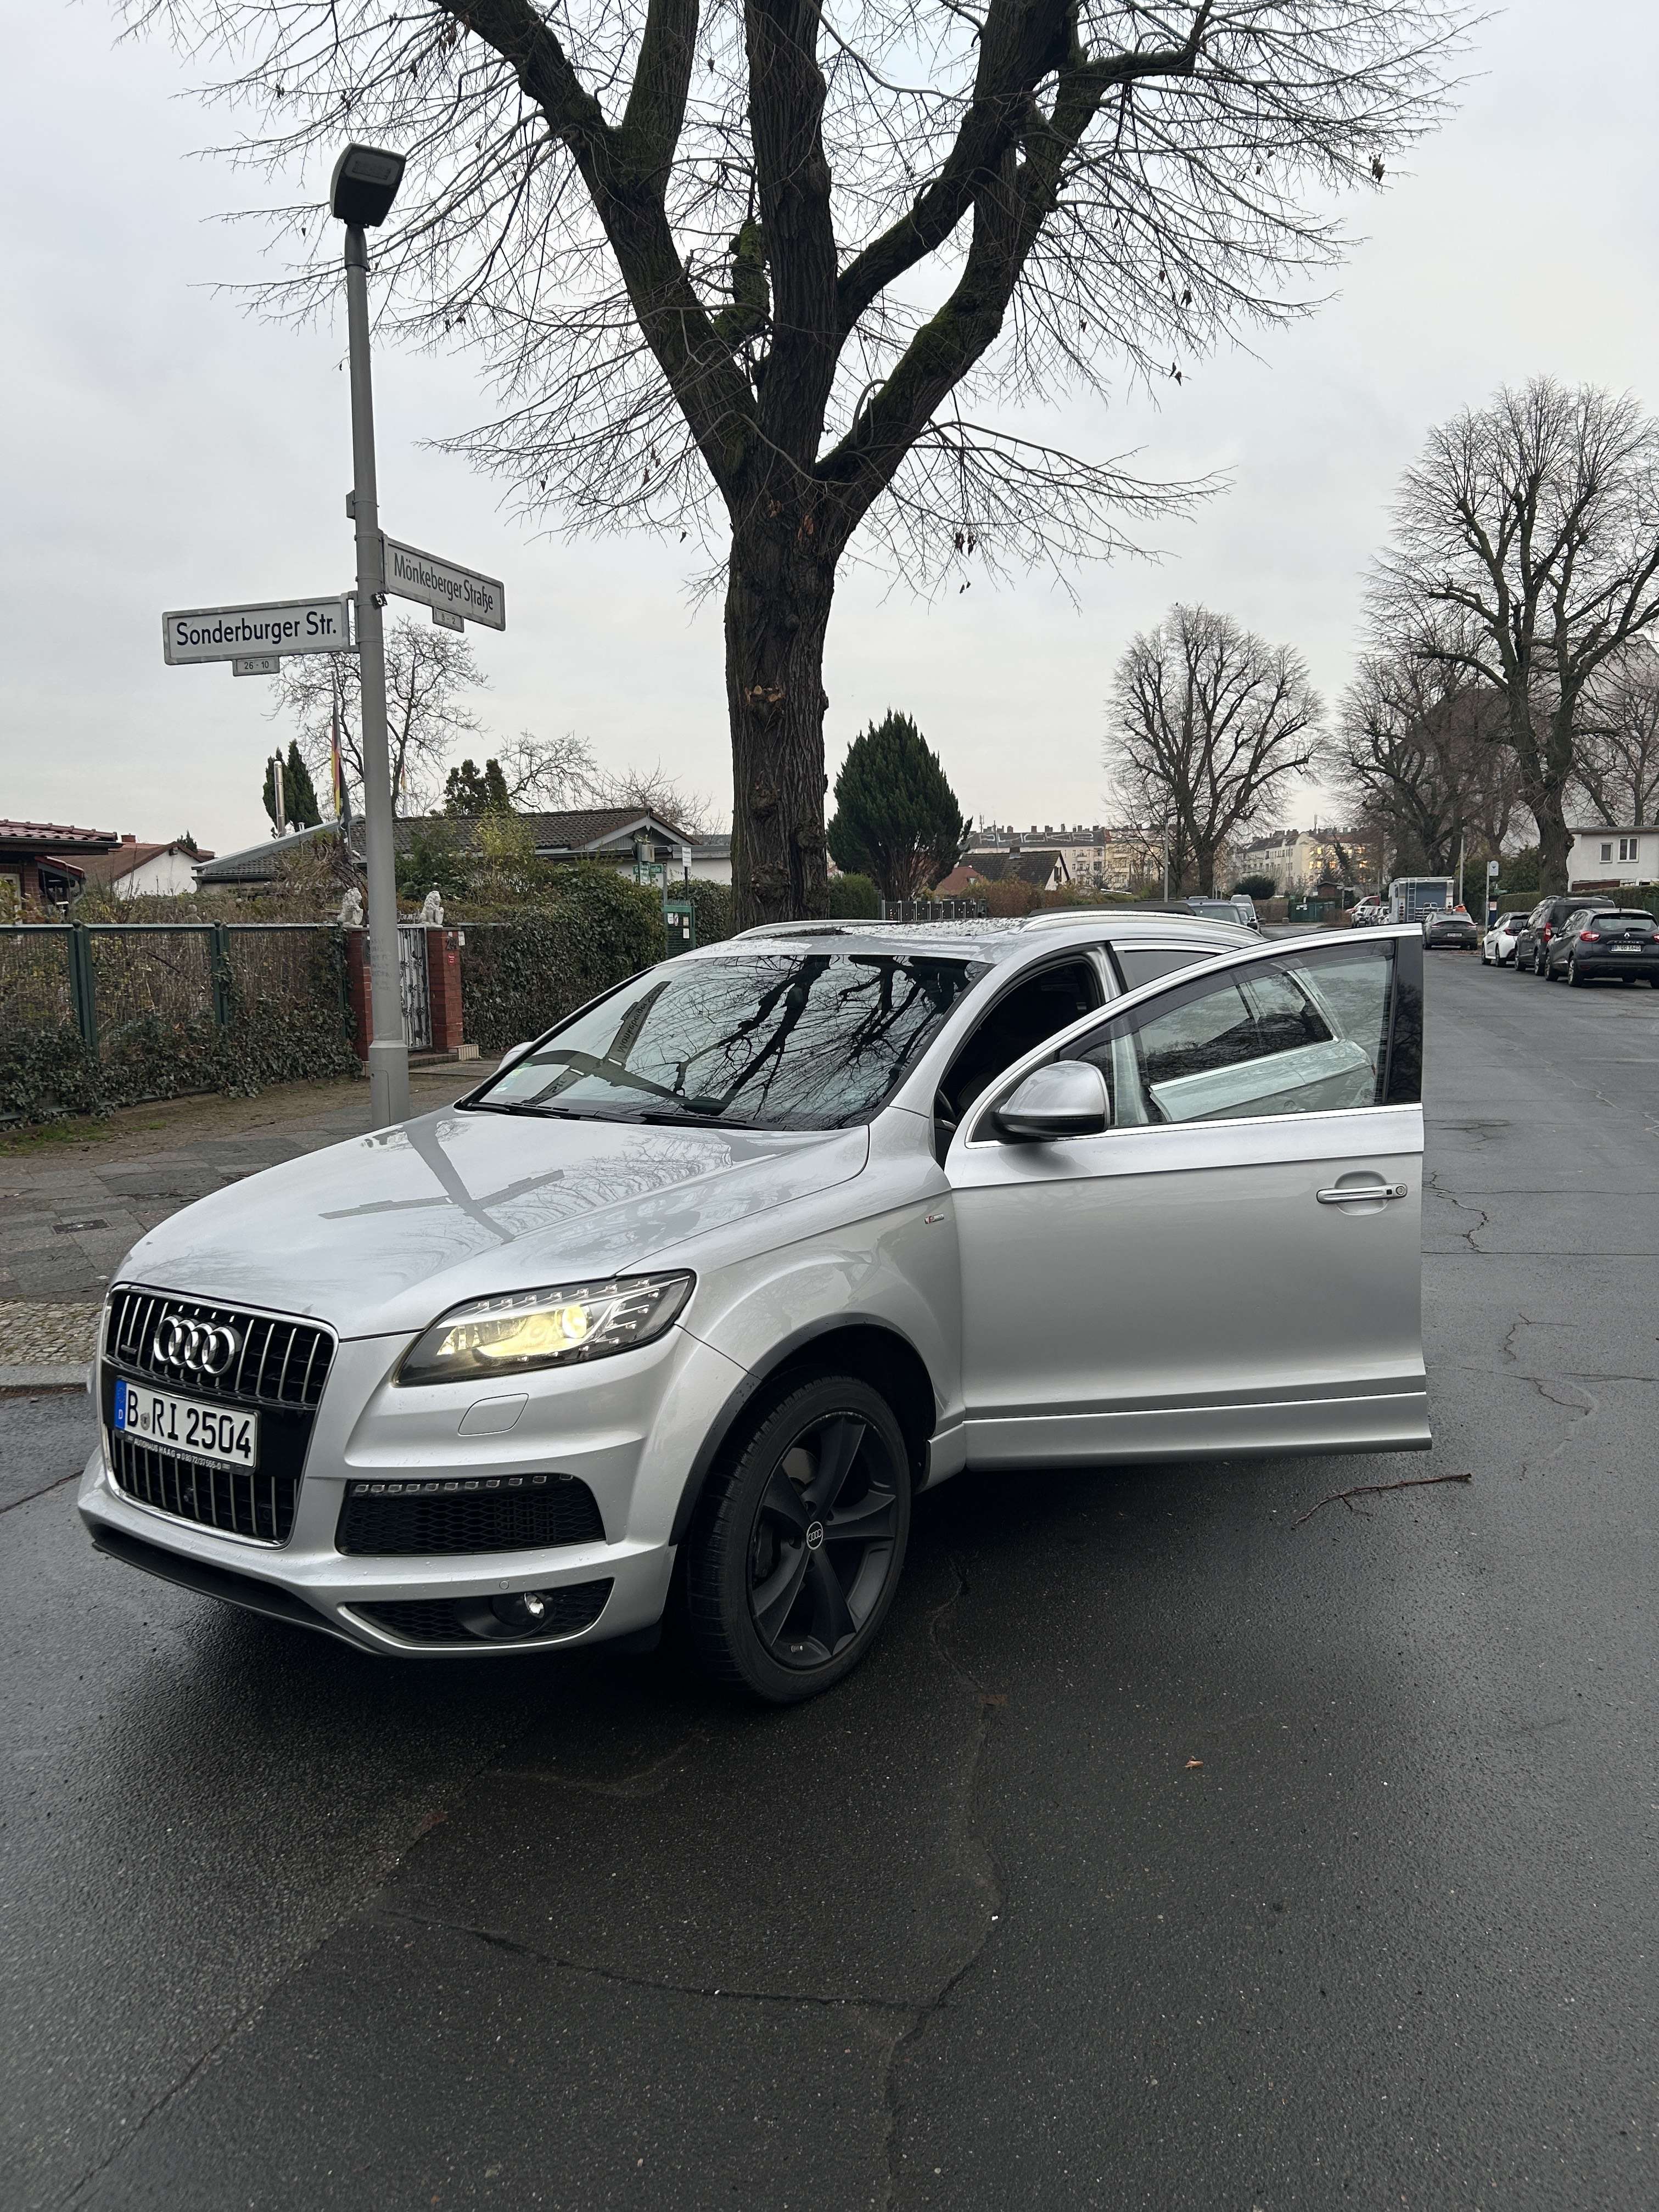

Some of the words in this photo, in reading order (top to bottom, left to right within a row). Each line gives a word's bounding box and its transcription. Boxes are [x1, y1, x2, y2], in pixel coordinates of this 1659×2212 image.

[394, 552, 462, 602] Mönkeberger
[463, 579, 494, 614] Straße
[176, 617, 300, 645] Sonderburger
[306, 611, 337, 636] Str.
[244, 661, 254, 670] 26
[261, 660, 269, 669] 10
[127, 1389, 138, 1427] B
[152, 1397, 178, 1441] RI
[186, 1407, 251, 1459] 2504
